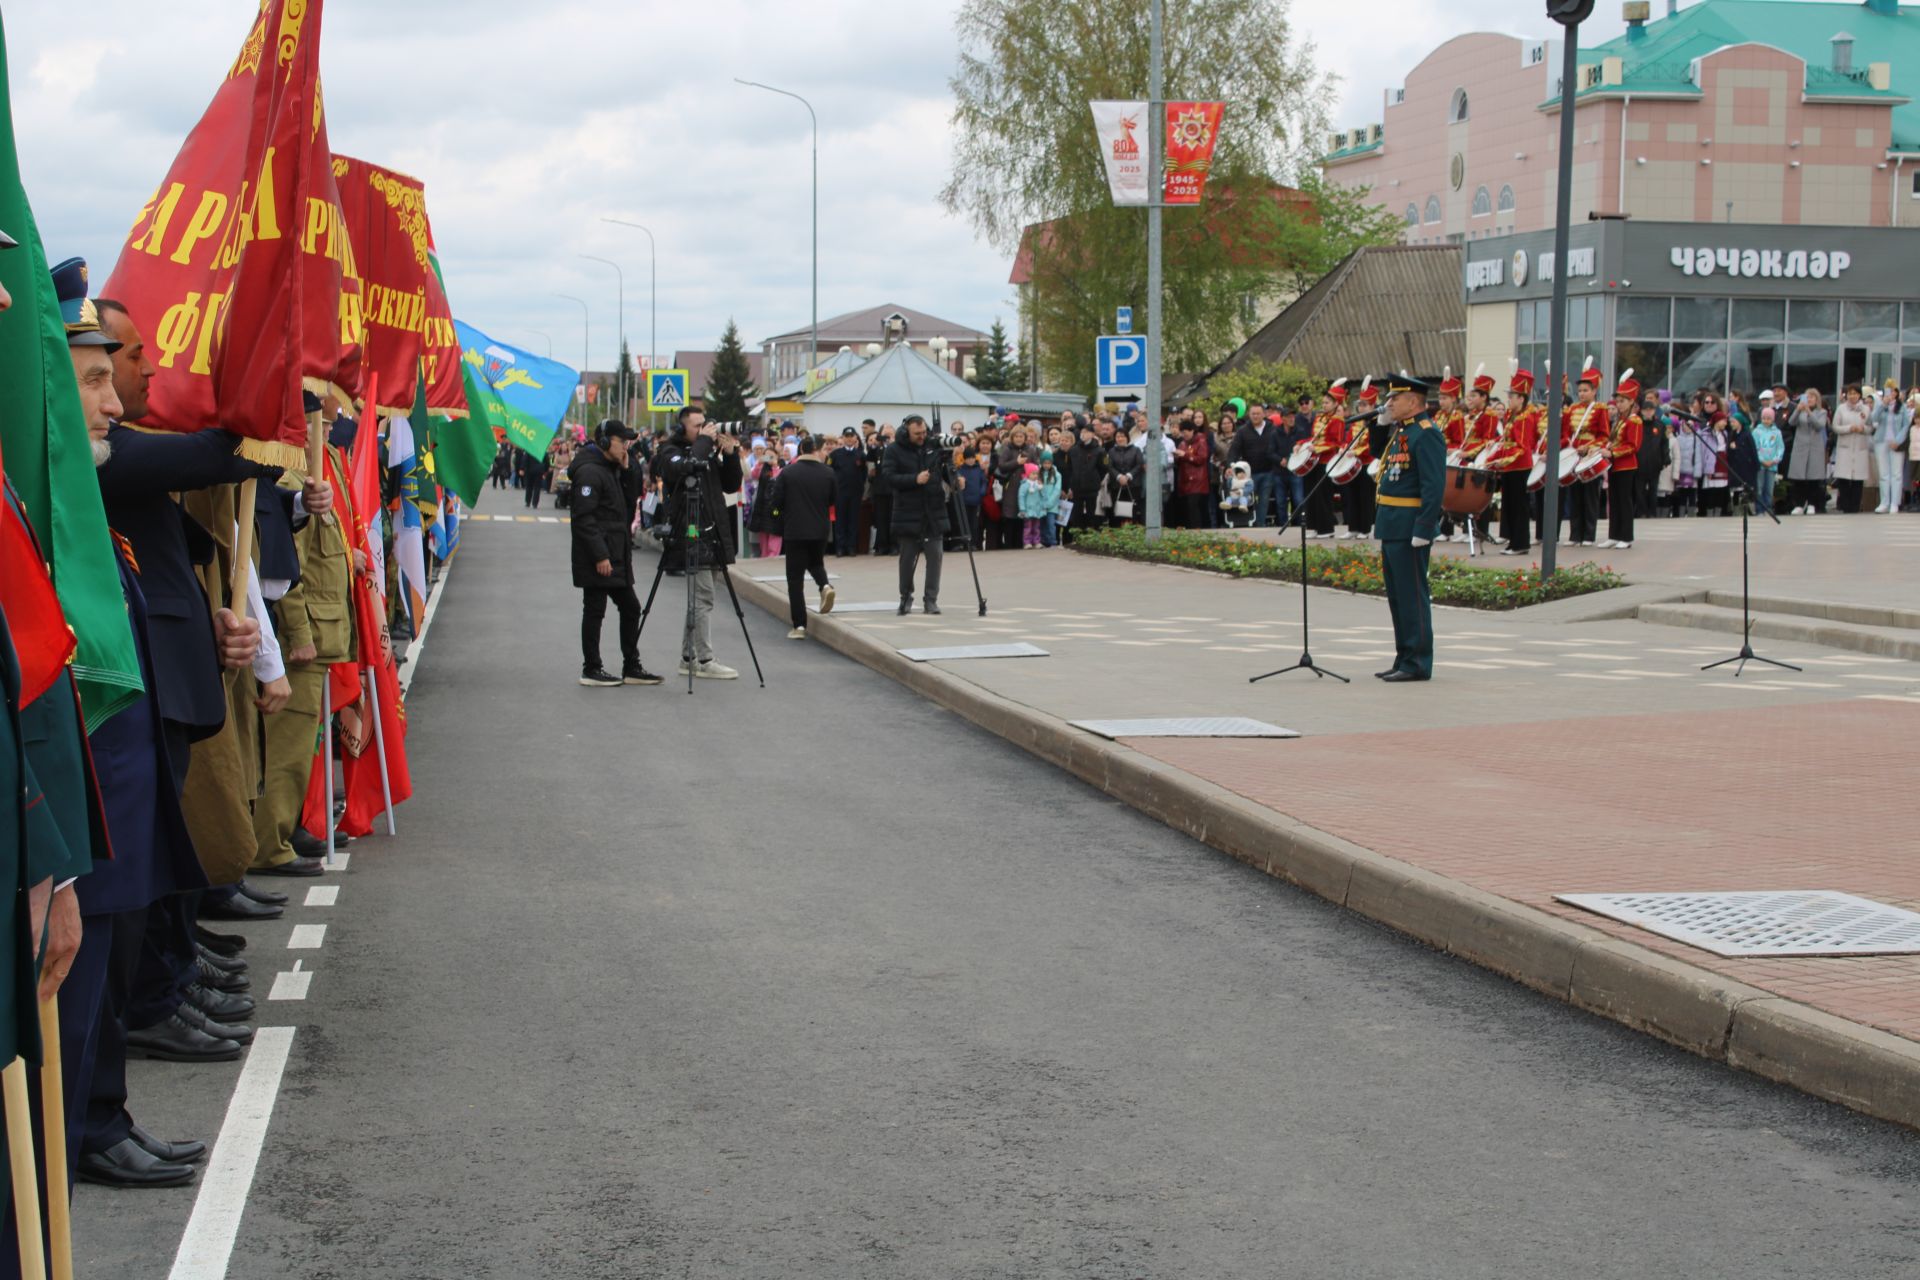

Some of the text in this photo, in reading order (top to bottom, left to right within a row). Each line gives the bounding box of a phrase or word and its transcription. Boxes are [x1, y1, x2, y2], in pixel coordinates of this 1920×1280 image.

[1119, 165, 1141, 173] 2025
[1169, 175, 1199, 184] 1945-
[1169, 186, 1198, 195] -2025
[1109, 340, 1140, 384] P
[511, 419, 537, 441] НАС
